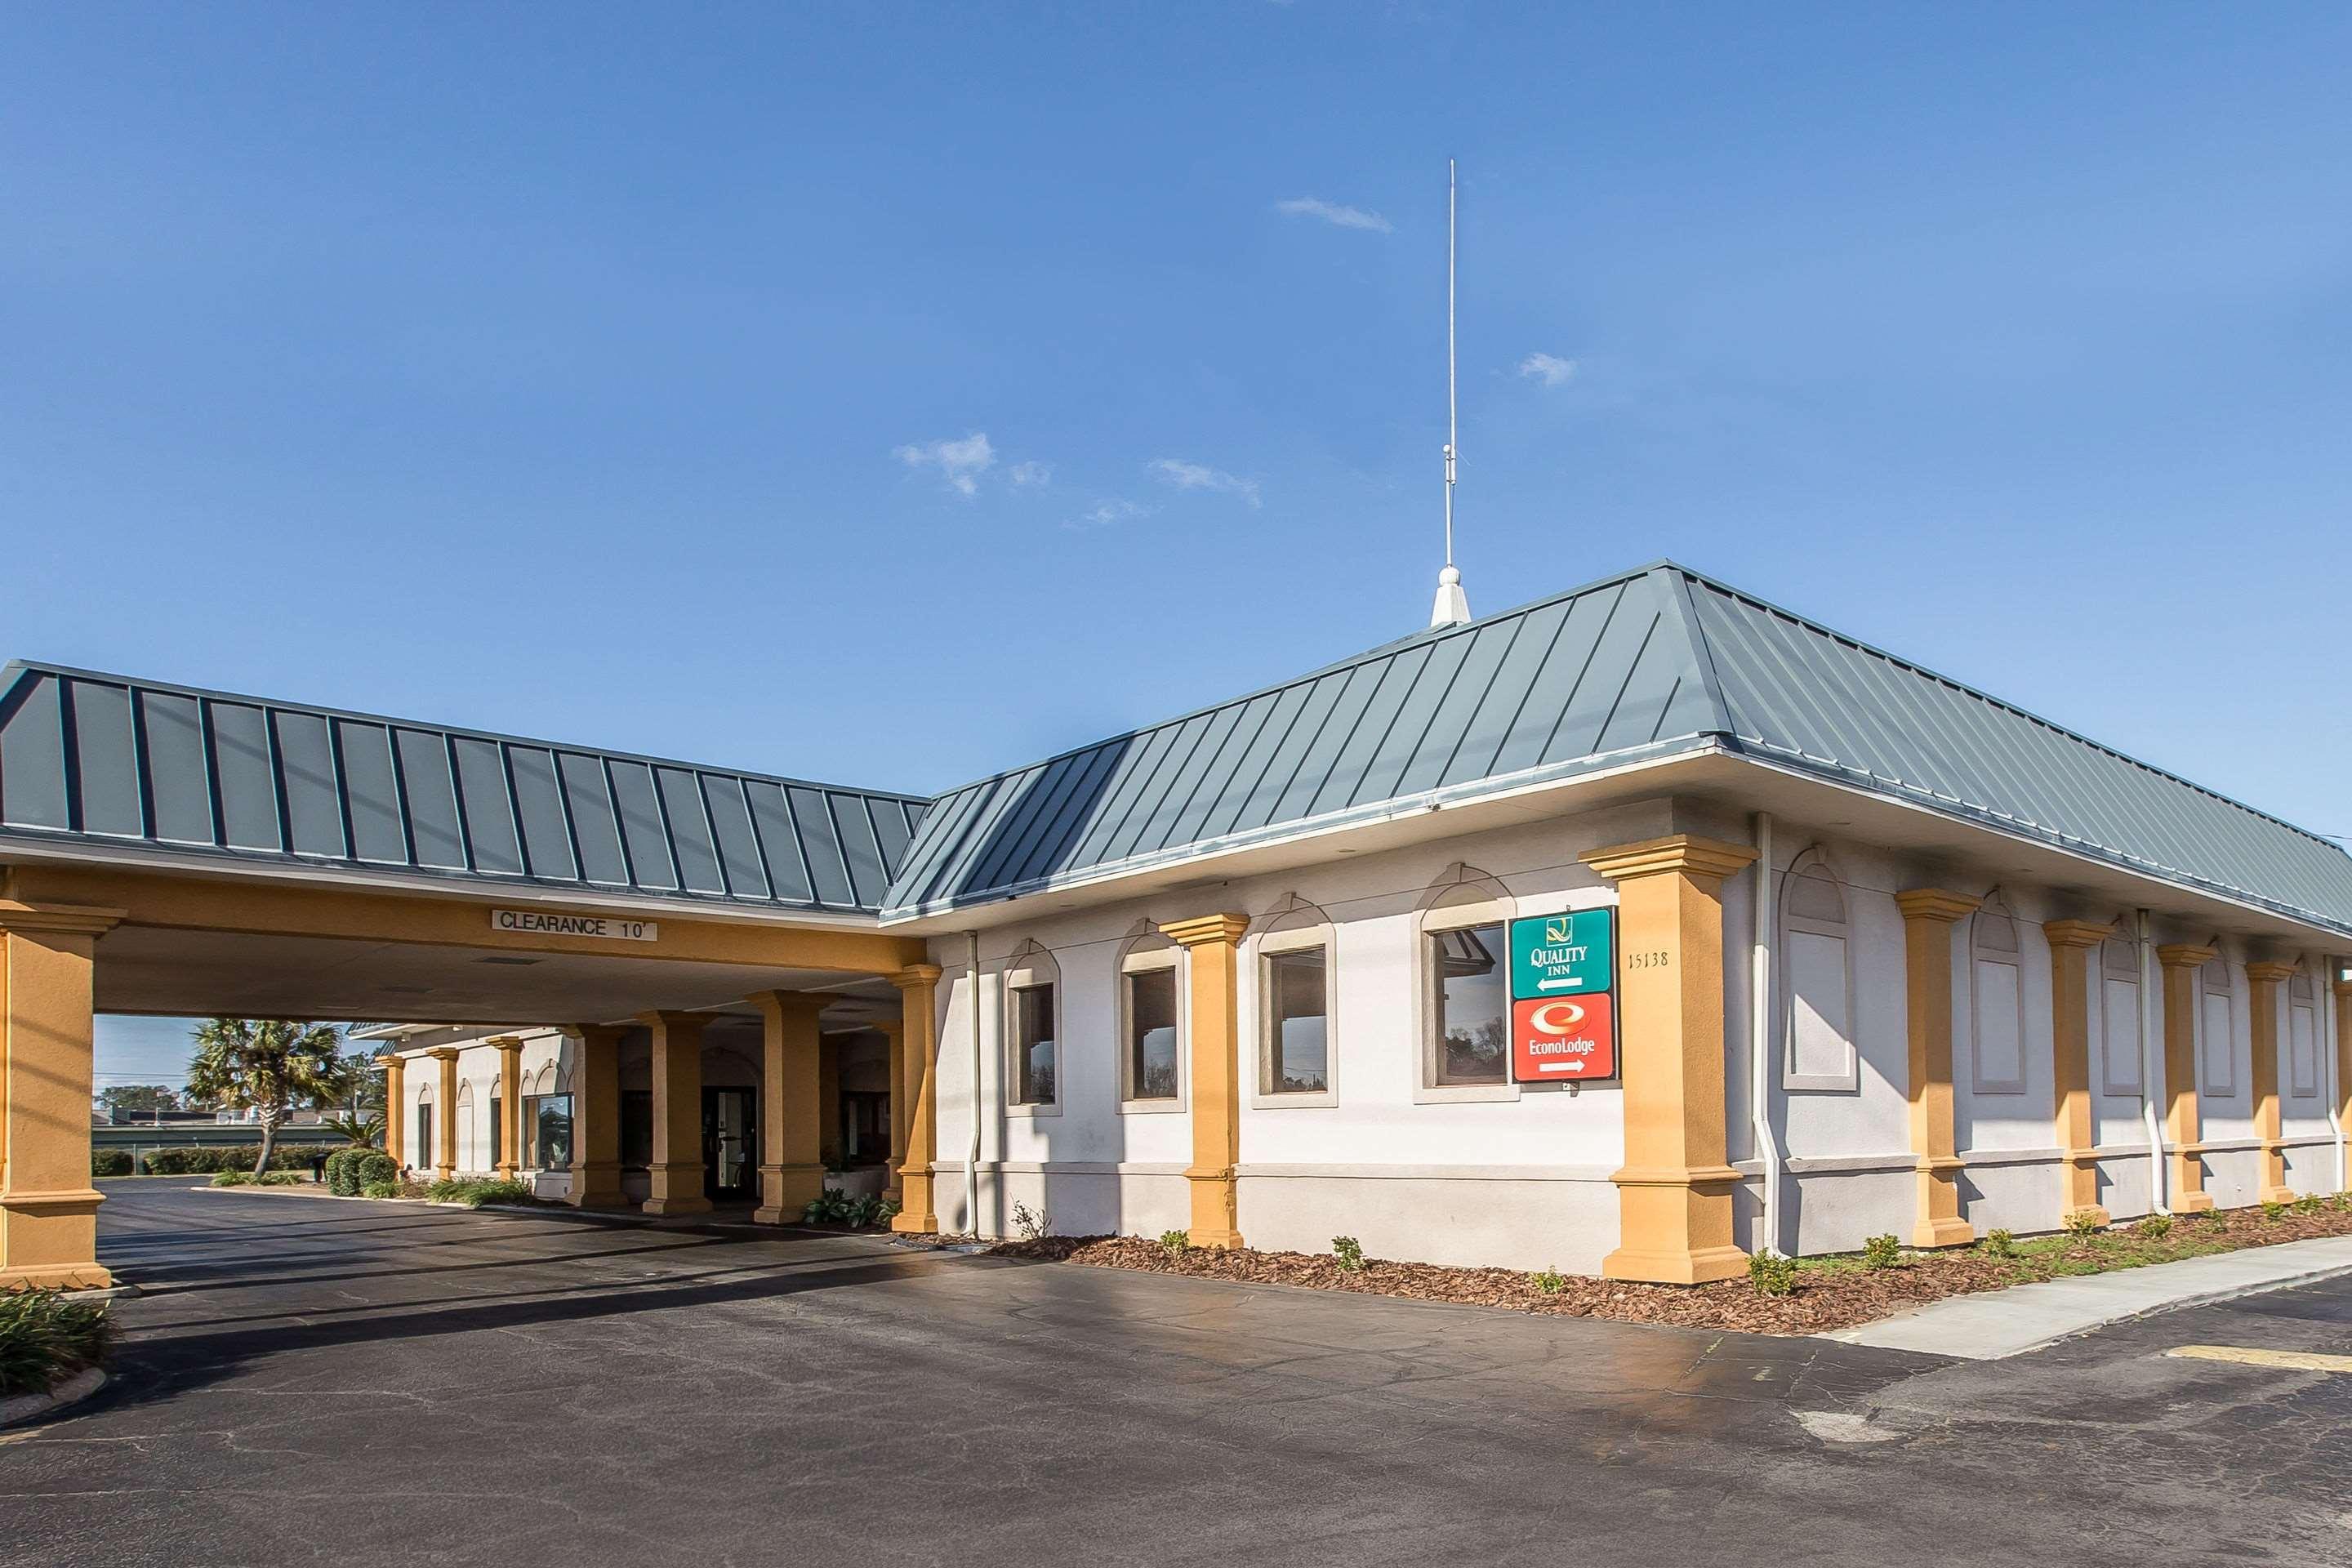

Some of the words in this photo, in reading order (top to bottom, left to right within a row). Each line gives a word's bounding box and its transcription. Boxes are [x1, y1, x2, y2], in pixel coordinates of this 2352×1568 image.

[501, 911, 607, 936] CLEARANCE
[1530, 946, 1588, 967] QUALITY
[1628, 951, 1668, 969] 15138
[1547, 964, 1570, 977] INN
[1529, 1037, 1595, 1055] EconoLodge
